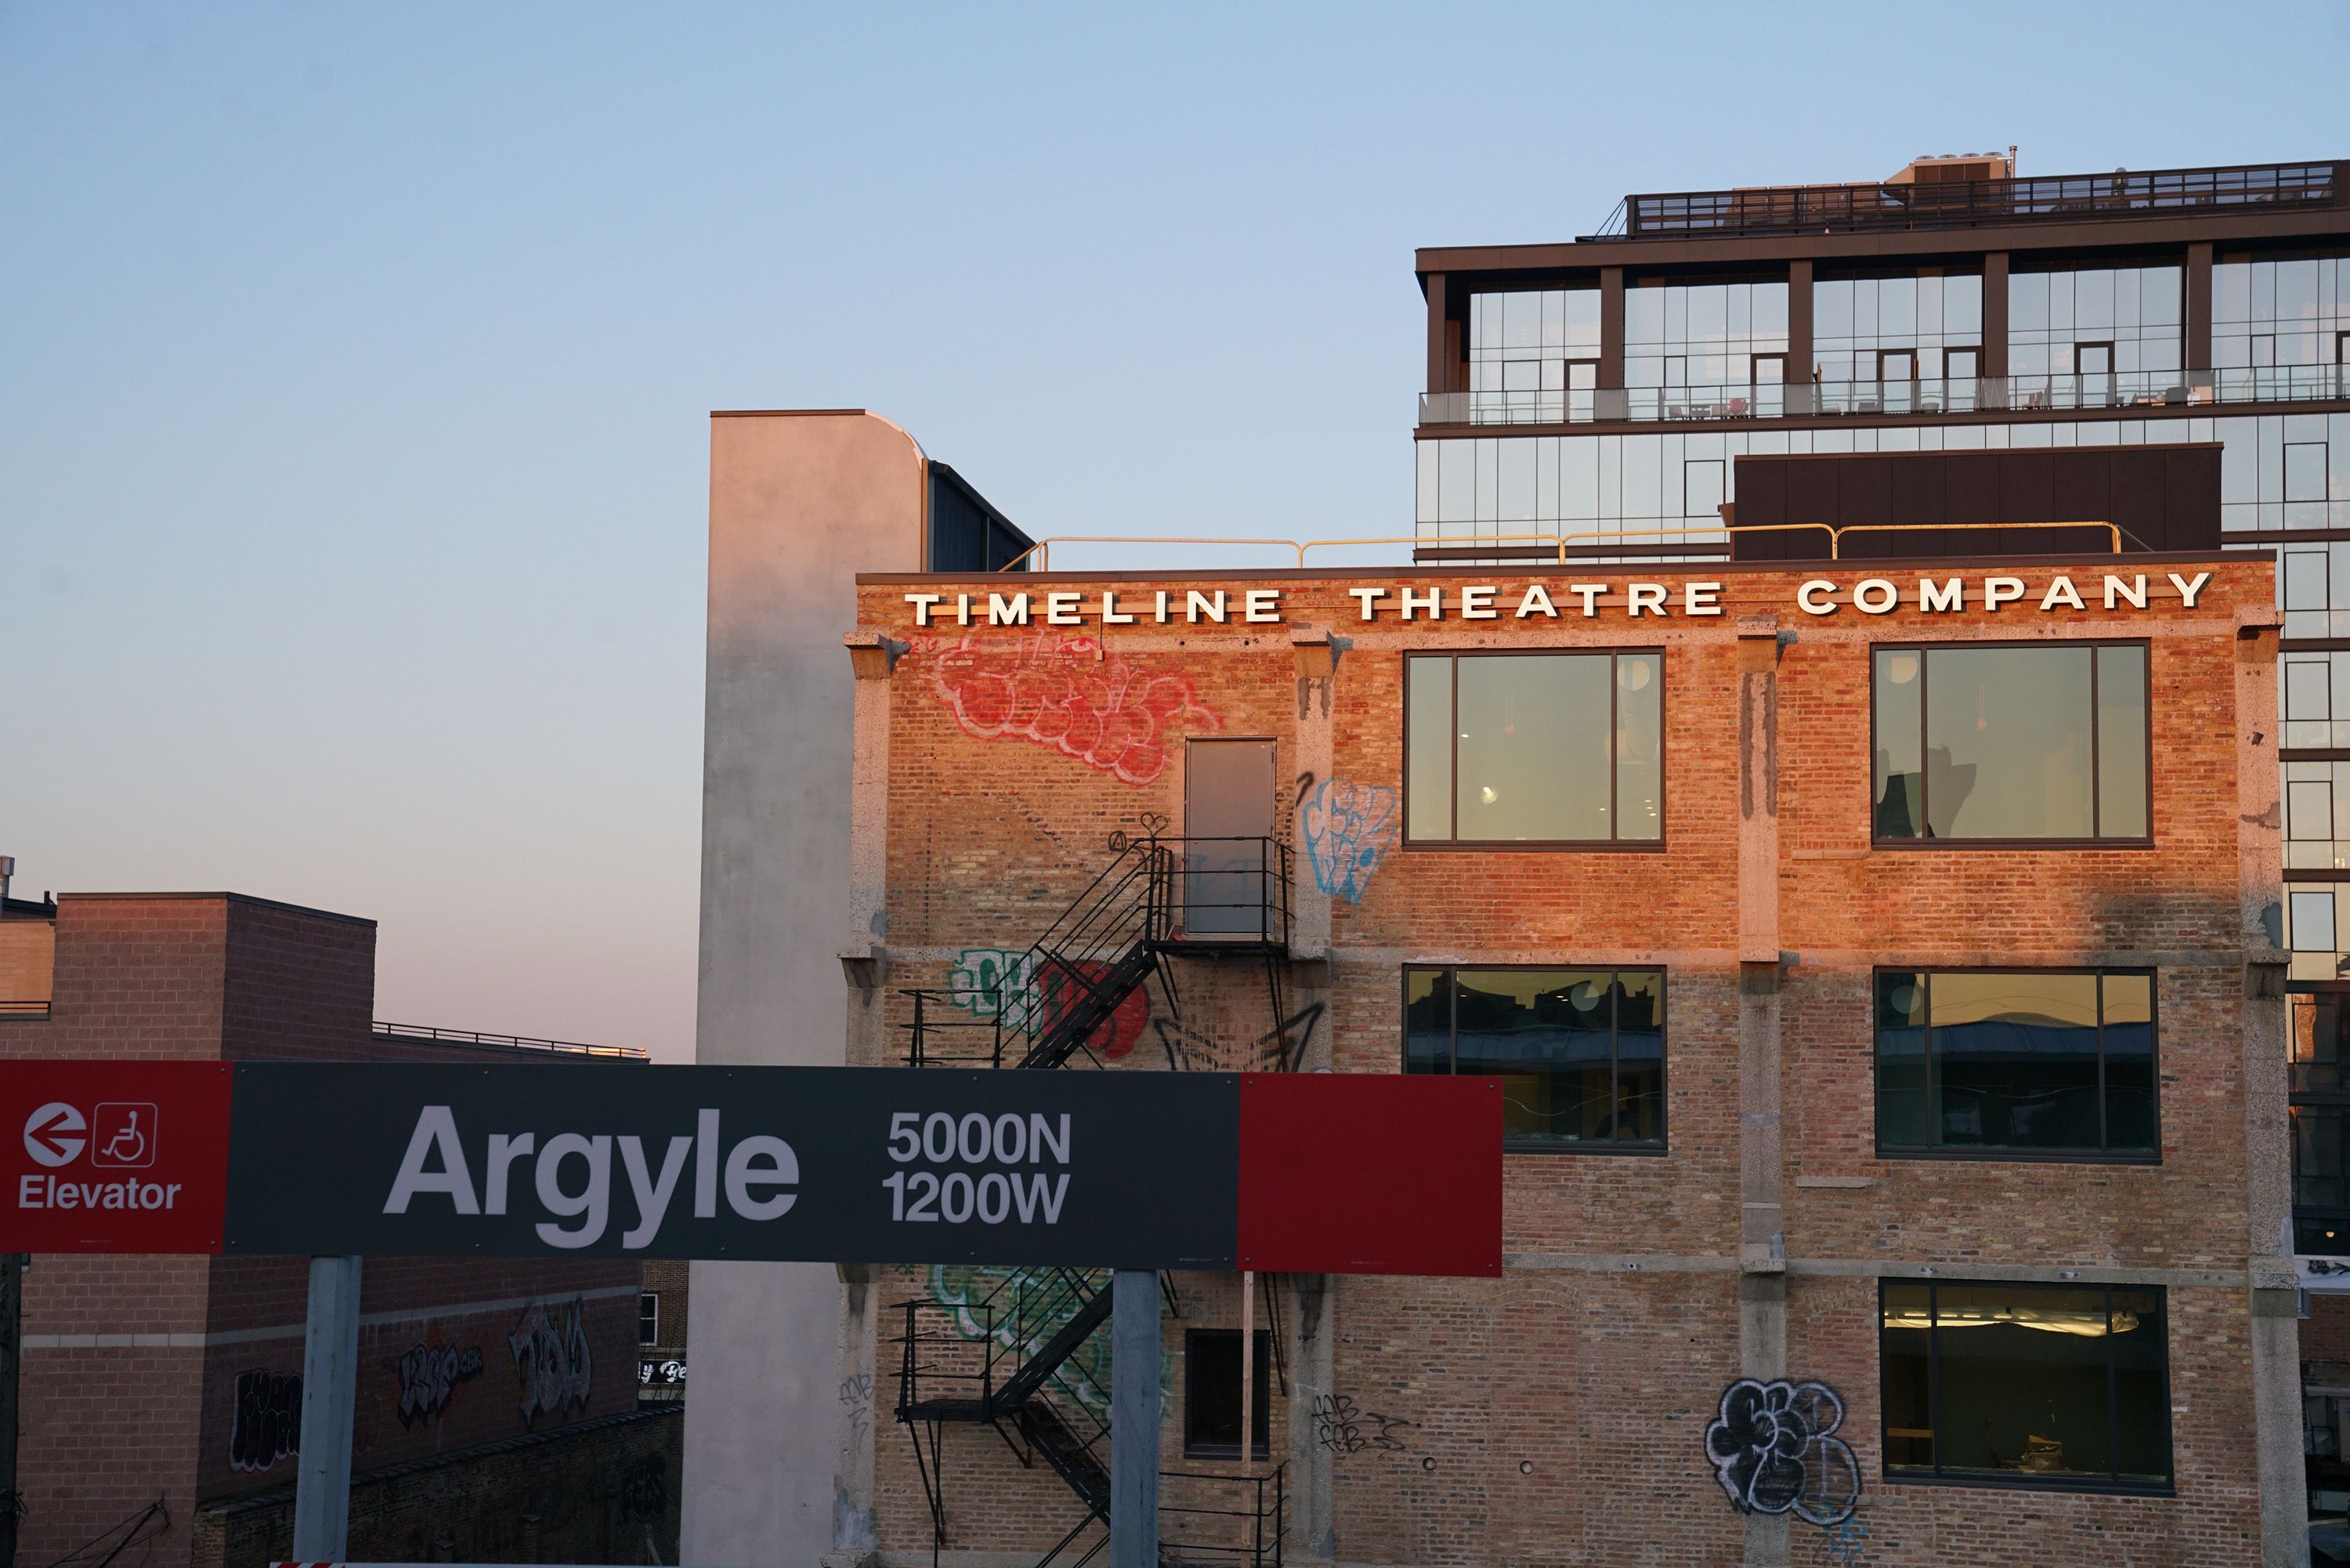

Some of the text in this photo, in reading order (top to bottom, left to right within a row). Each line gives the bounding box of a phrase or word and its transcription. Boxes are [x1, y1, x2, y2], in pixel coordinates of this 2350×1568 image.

[904, 572, 2211, 626] TIMELINE THEATRE COMPANY
[887, 1111, 1072, 1165] 5000N
[18, 1174, 182, 1210] Elevator
[382, 1104, 800, 1250] Argyle
[881, 1171, 1072, 1225] 1200W
